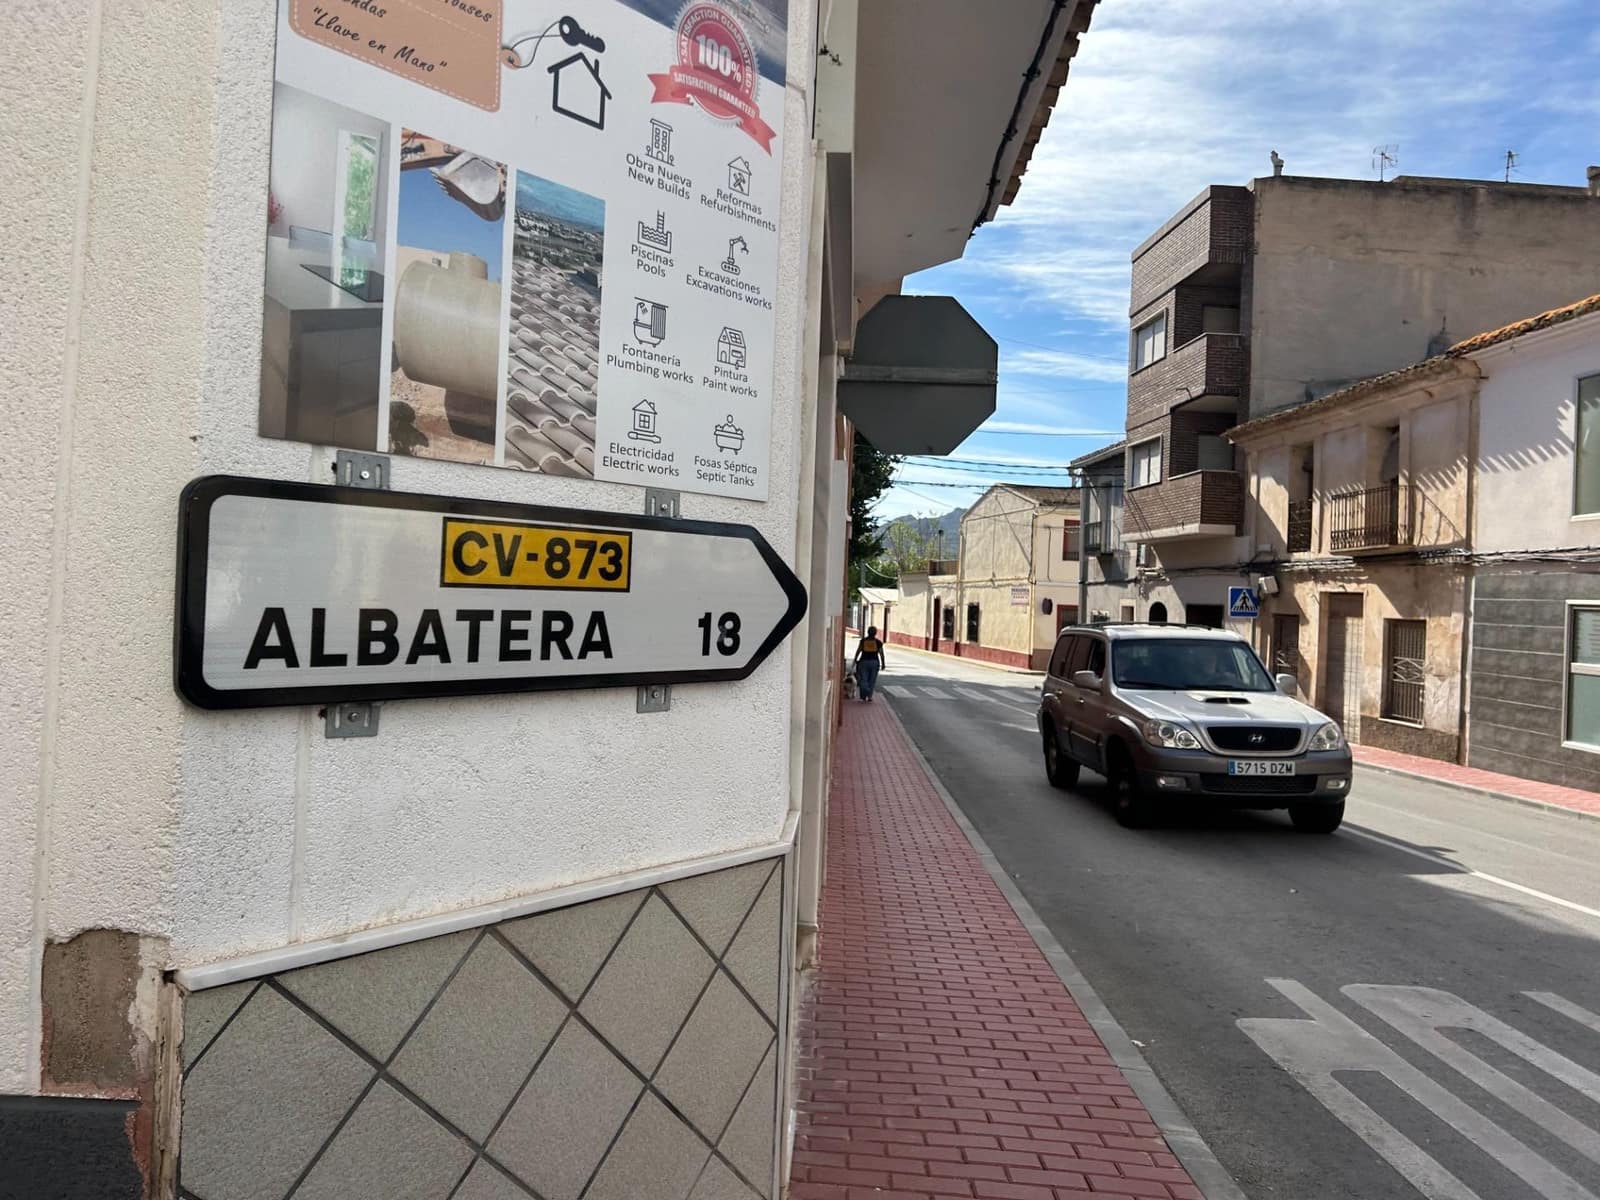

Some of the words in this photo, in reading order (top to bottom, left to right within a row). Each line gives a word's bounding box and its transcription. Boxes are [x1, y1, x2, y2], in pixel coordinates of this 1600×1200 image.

[444, 0, 492, 22] ouses
[680, 8, 719, 57] SATISFACTION
[368, 39, 387, 54] en
[696, 34, 742, 83] 100%
[626, 153, 654, 173] Obra
[657, 165, 692, 188] Nueva
[628, 166, 654, 186] New
[657, 177, 690, 200] Builds
[701, 194, 776, 232] Refurbishments
[716, 188, 762, 215] Reformas
[631, 244, 674, 267] Piscinas
[637, 258, 666, 278] Pools
[686, 274, 742, 301] Excavations
[745, 294, 772, 310] works
[698, 265, 760, 295] Excavaciones
[606, 354, 660, 379] Plumbing
[662, 367, 694, 384] works
[714, 365, 748, 383] Pintura
[703, 376, 727, 391] Paint
[729, 384, 758, 398] works
[609, 442, 674, 462] Electricidad
[694, 455, 722, 469] Fosas
[724, 459, 758, 474] Séptica
[602, 456, 644, 472] Electric
[647, 464, 680, 477] works
[696, 469, 726, 483] Septic
[729, 474, 754, 487] Tanks
[452, 530, 623, 581] CV-873
[243, 607, 613, 669] ALBATERA
[698, 611, 741, 657] 18
[1236, 762, 1267, 774] 5715
